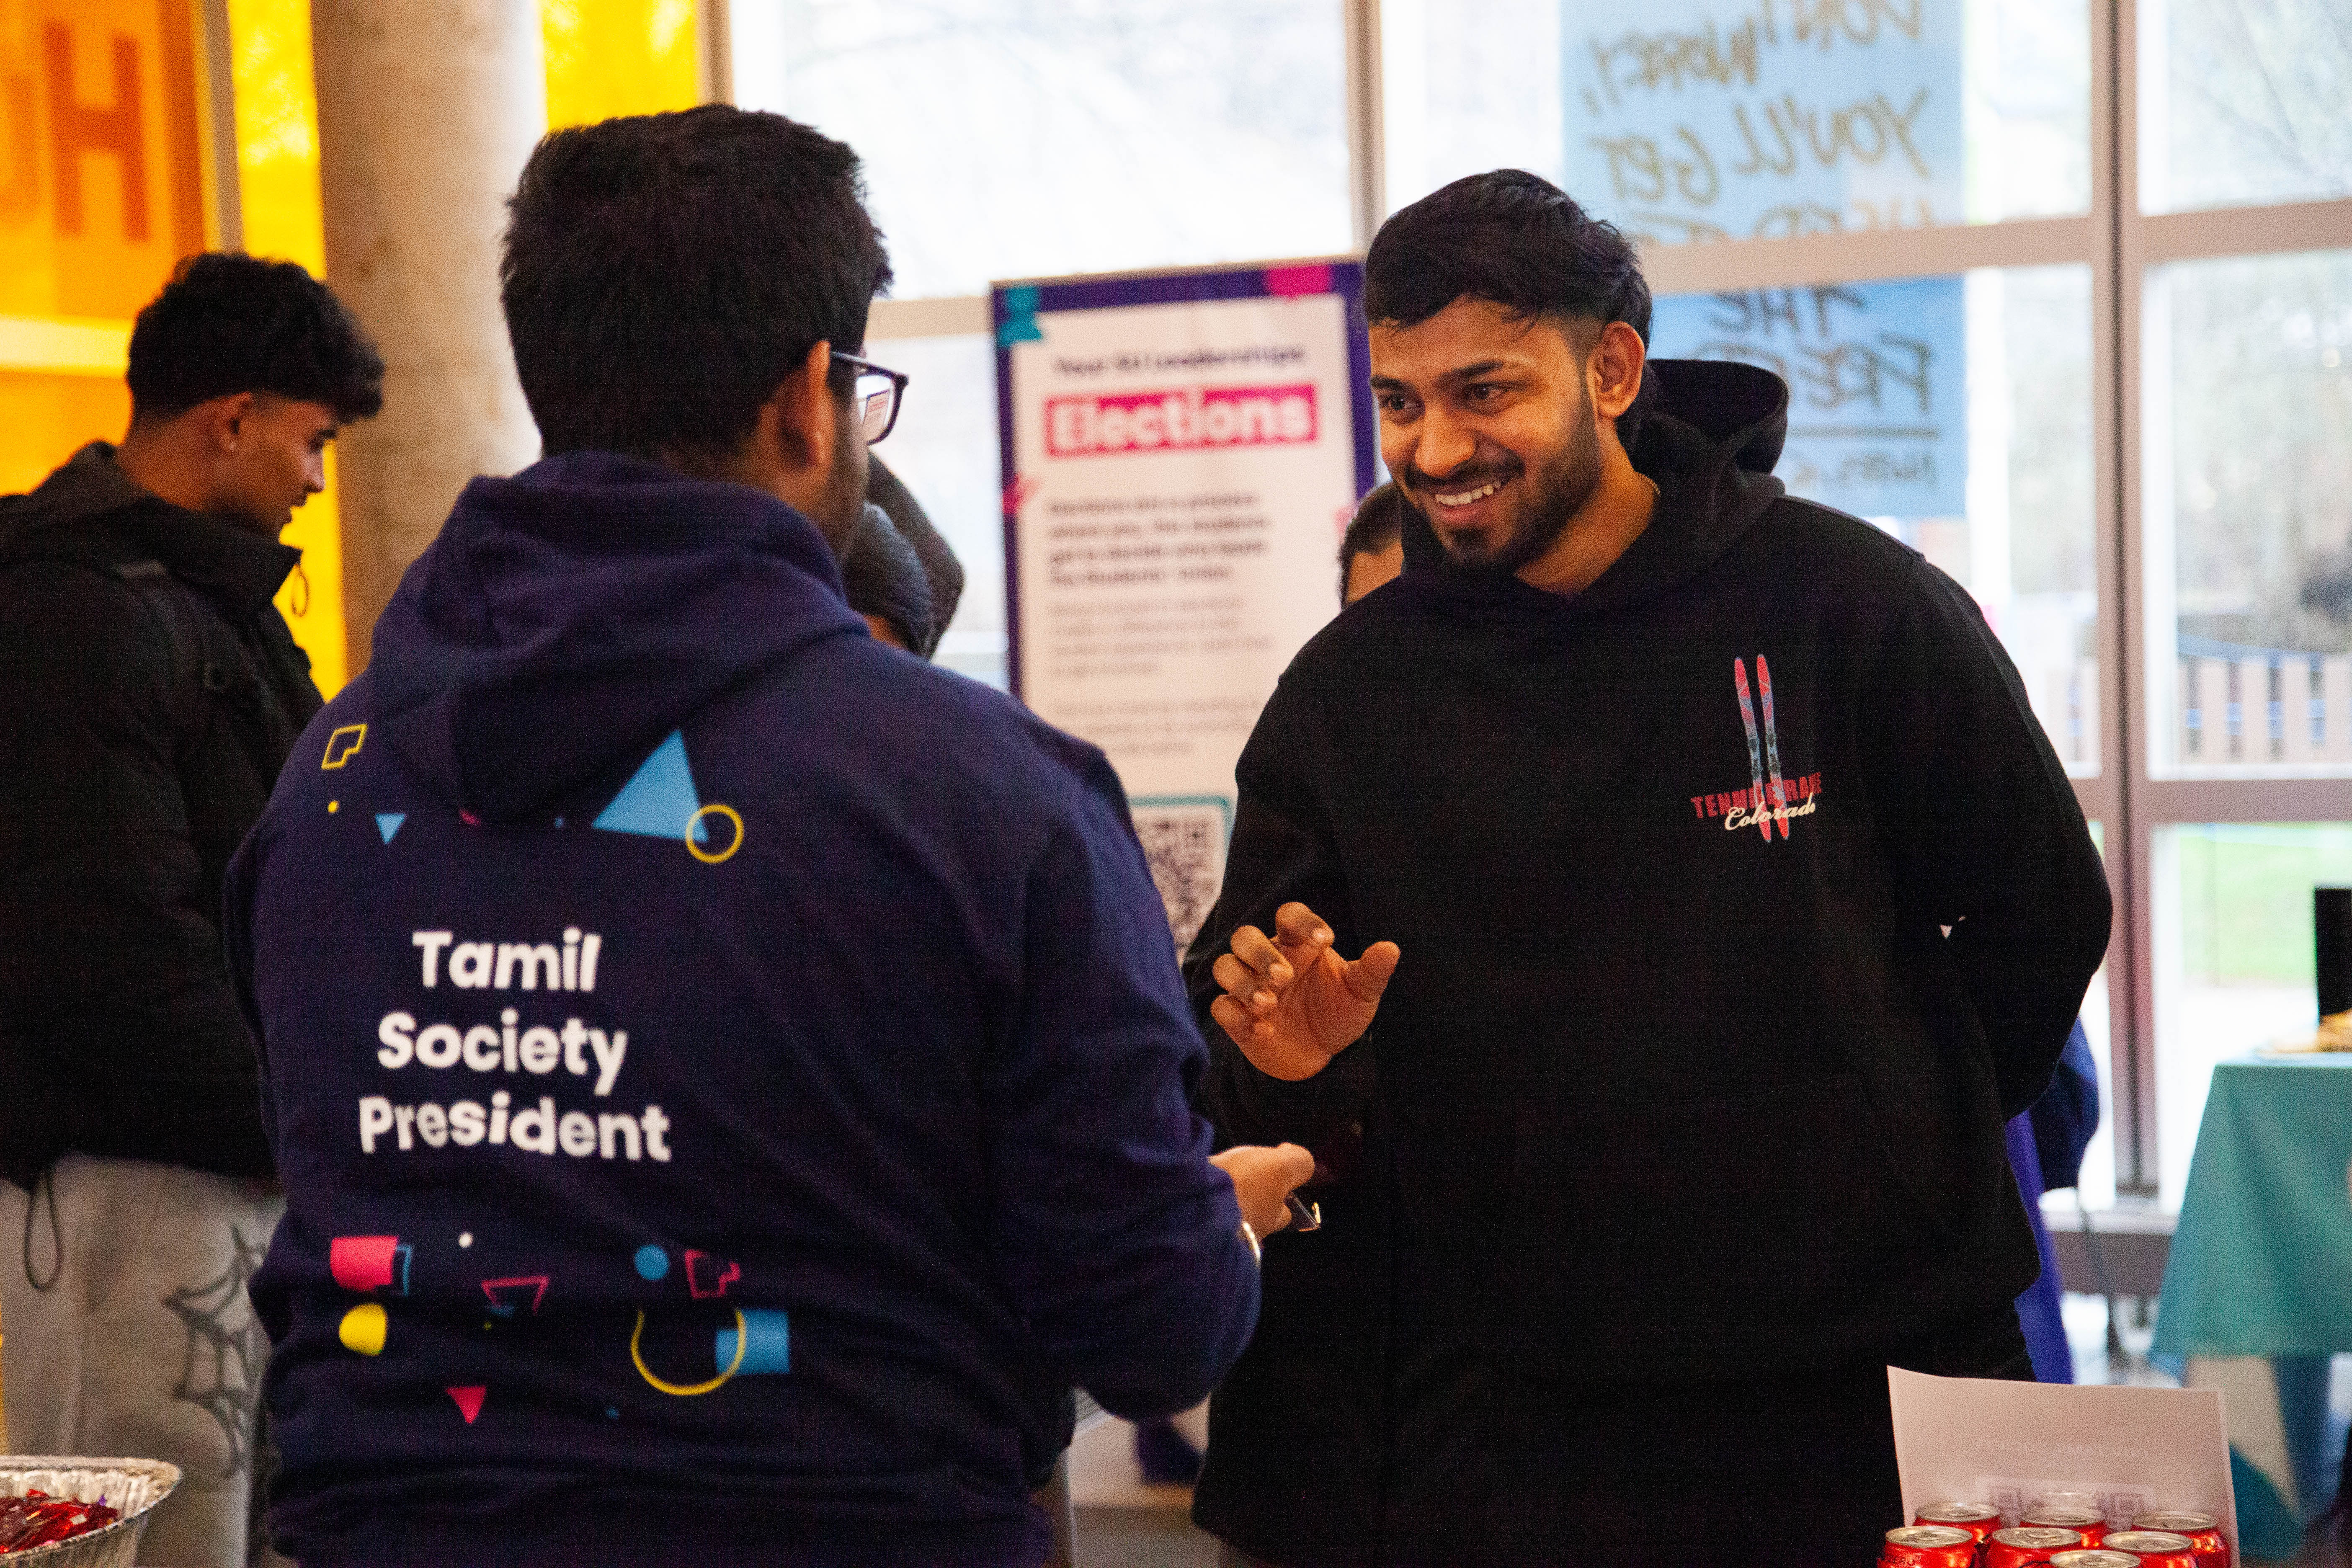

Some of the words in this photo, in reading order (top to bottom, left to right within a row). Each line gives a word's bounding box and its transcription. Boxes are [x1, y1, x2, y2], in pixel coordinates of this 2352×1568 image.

[1052, 388, 1310, 450] Elections
[1724, 792, 1816, 830] Colorado
[412, 926, 602, 992] Tamil
[377, 1007, 629, 1096] Society
[358, 1090, 671, 1162] President
